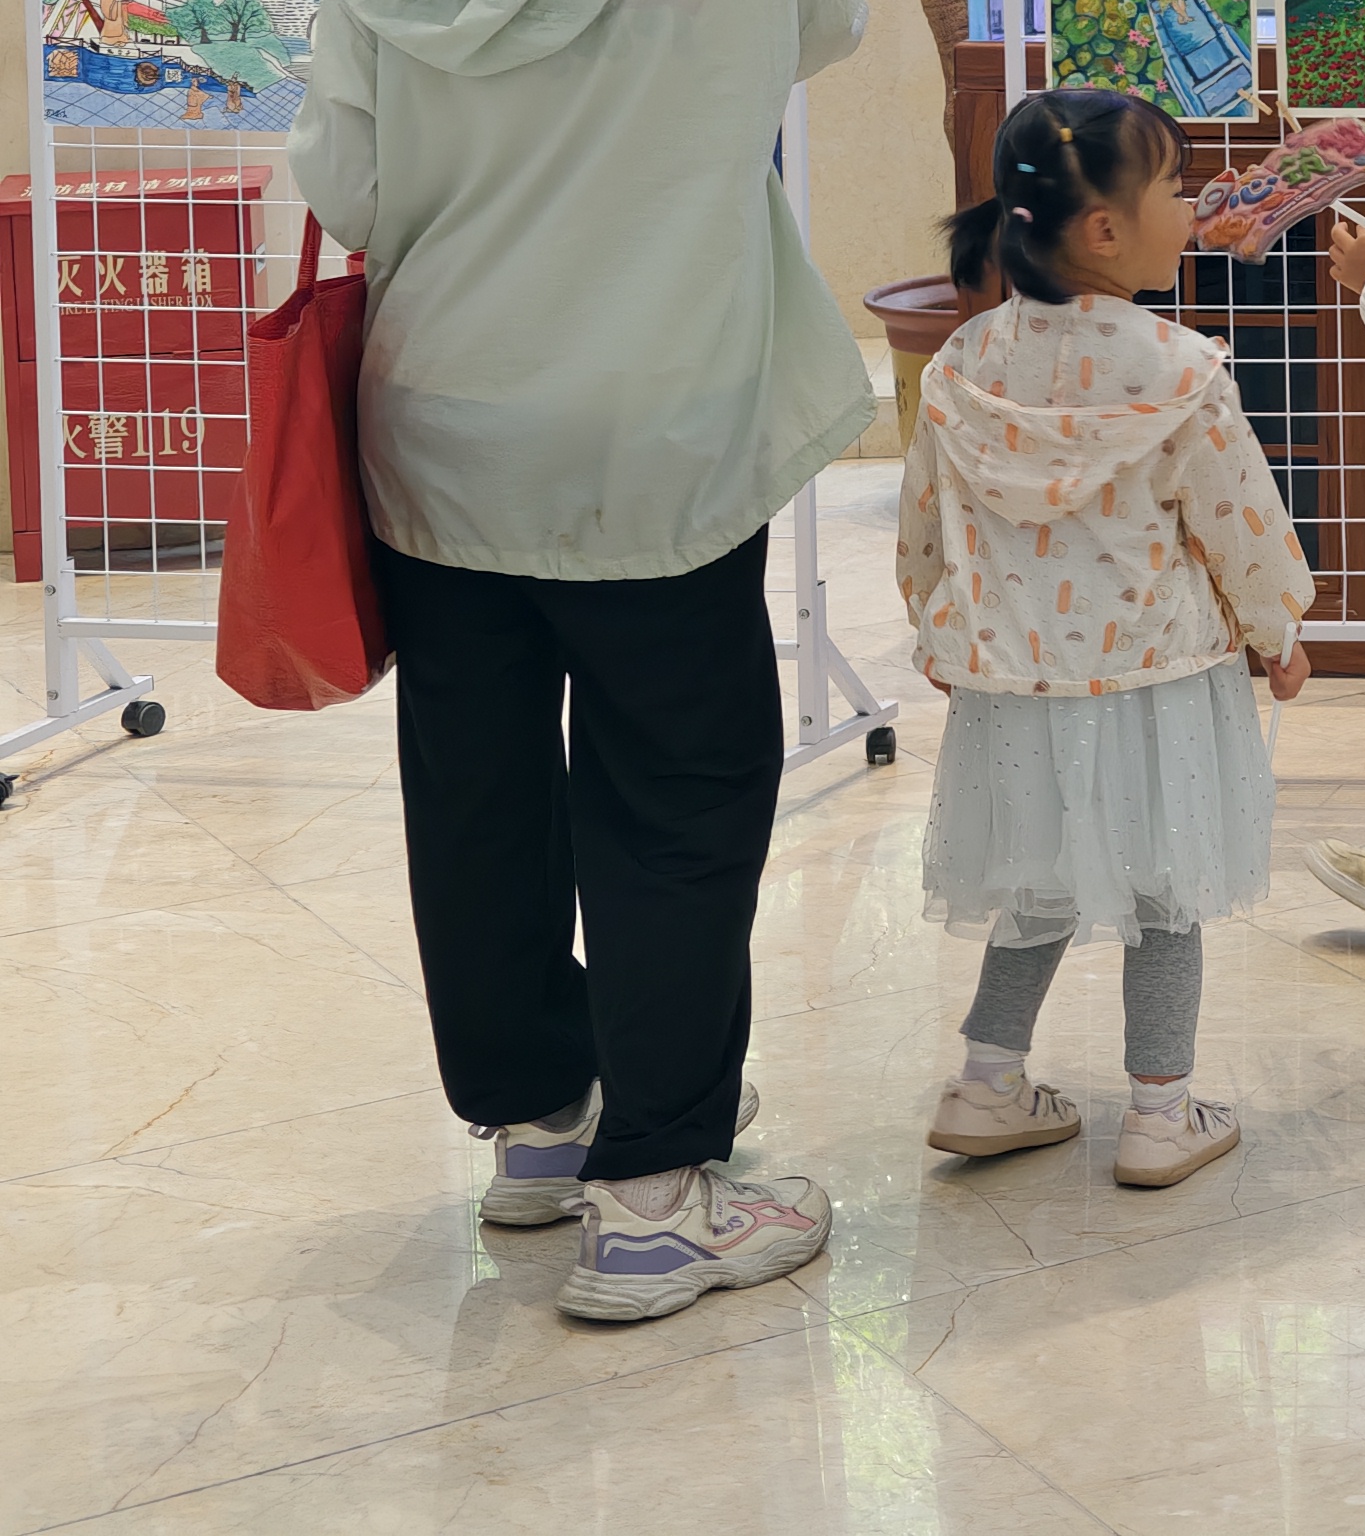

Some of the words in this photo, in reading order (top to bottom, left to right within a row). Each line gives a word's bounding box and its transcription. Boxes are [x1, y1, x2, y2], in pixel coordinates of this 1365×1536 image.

[58, 248, 213, 296] 灭火器箱
[60, 299, 84, 316] IRE
[85, 295, 183, 315] EXTINGSHER
